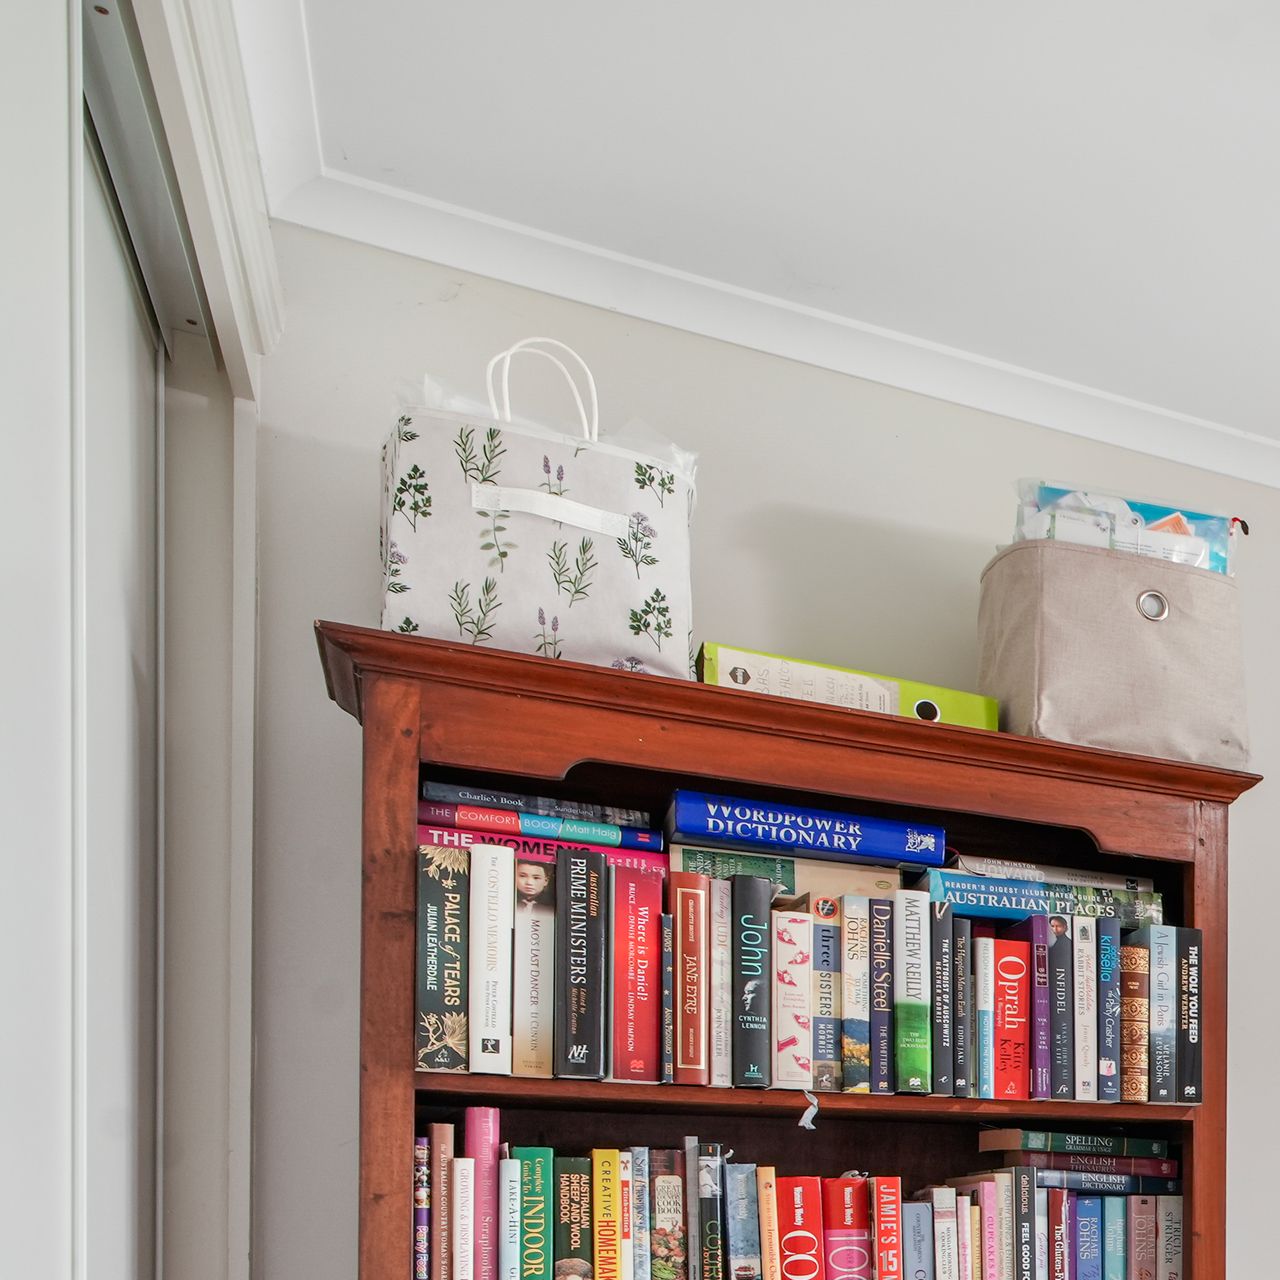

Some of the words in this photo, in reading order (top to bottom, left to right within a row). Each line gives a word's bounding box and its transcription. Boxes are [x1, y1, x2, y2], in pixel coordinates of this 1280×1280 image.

[500, 797, 525, 808] Book
[430, 807, 451, 818] THE
[459, 810, 516, 826] COMFORT
[523, 819, 560, 831] BOOK
[565, 823, 590, 837] Matt
[592, 827, 618, 840] Haig
[706, 802, 863, 836] WORDPOWER
[706, 817, 863, 851] DICTIONARY
[429, 829, 473, 847] THE
[570, 858, 588, 901] PRIME
[590, 870, 602, 917] Australian
[628, 882, 637, 905] BRUCE
[944, 881, 986, 891] READER'S
[989, 885, 1019, 895] DIGEST
[1021, 889, 1074, 899] ILLUSTRATED
[1077, 893, 1101, 903] GUIDE
[1103, 895, 1115, 904] TO
[427, 903, 439, 931] JULIAN
[444, 892, 461, 944] PALACE
[943, 891, 1051, 912] AUSTRALIAN
[1055, 901, 1116, 918] PLACES
[530, 919, 542, 949] MAO'S
[638, 906, 650, 946] Where
[845, 915, 860, 961] JOHNS
[872, 904, 892, 970] Danielle
[904, 897, 921, 962] MATTHEW
[439, 940, 461, 961] of
[570, 902, 587, 985] MINISTERS
[638, 948, 649, 956] is
[740, 914, 769, 977] John
[821, 928, 835, 967] three
[942, 938, 950, 952] THE
[1101, 935, 1113, 983] kinsella
[1188, 945, 1198, 966] THE
[427, 932, 438, 991] LEATHERDALE
[530, 949, 542, 971] LAST
[684, 953, 698, 984] JANE
[942, 953, 950, 992] TATTOOIST
[1181, 957, 1189, 991] ANDREW
[444, 960, 461, 1007] TEARS
[529, 972, 541, 1007] DANCER
[637, 959, 650, 1001] Daniel?
[819, 973, 832, 1017] SISTERS
[872, 972, 893, 1013] Steel
[905, 963, 922, 1001] REILLY
[998, 955, 1028, 1030] Oprah
[1056, 967, 1067, 1015] INFIDEL
[1157, 972, 1169, 995] Girl
[1188, 967, 1198, 995] WOLF
[627, 992, 637, 1020] LINDSAY
[684, 985, 698, 1015] EYRE
[942, 994, 950, 1003] OF
[1105, 997, 1115, 1020] Party
[1181, 993, 1189, 1030] WEBSTER
[1188, 996, 1198, 1020] YOU
[738, 1014, 768, 1024] CYNTHIA
[741, 1022, 767, 1031] LENNON
[942, 1005, 950, 1047] AUSCHWITZ
[1158, 1006, 1169, 1026] Paris
[627, 1021, 636, 1053] SIMPSON
[818, 1023, 827, 1055] MORRIS
[825, 1023, 834, 1060] HEATHER
[1105, 1020, 1115, 1049] Crasher
[1188, 1021, 1198, 1045] FEED
[996, 1038, 1012, 1072] Kelley
[1013, 1042, 1025, 1072] Kitty
[1162, 1043, 1170, 1077] MELANIE
[1065, 1135, 1114, 1148] SPELLING
[534, 1157, 545, 1194] Complete
[1069, 1156, 1117, 1167] ENGLISH
[570, 1173, 580, 1206] SHEEP
[601, 1160, 613, 1218] CREATIVE
[1081, 1172, 1127, 1184] ENGLISH
[1081, 1181, 1126, 1192] DICTIONARY
[559, 1173, 570, 1225] HANDBOOK
[580, 1173, 591, 1229] AUSTRALIAN
[880, 1183, 897, 1245] JAMIE'S
[570, 1207, 580, 1225] AND
[1054, 1224, 1065, 1240] The
[522, 1195, 545, 1277] INDOOR
[570, 1226, 580, 1251] WOOL
[986, 1215, 996, 1269] CUPCAKES
[1021, 1222, 1030, 1245] FEEL
[1077, 1216, 1092, 1261] JOHNS
[1164, 1211, 1174, 1265] STRINGER
[880, 1249, 898, 1272] 15
[1021, 1246, 1031, 1271] GOOD
